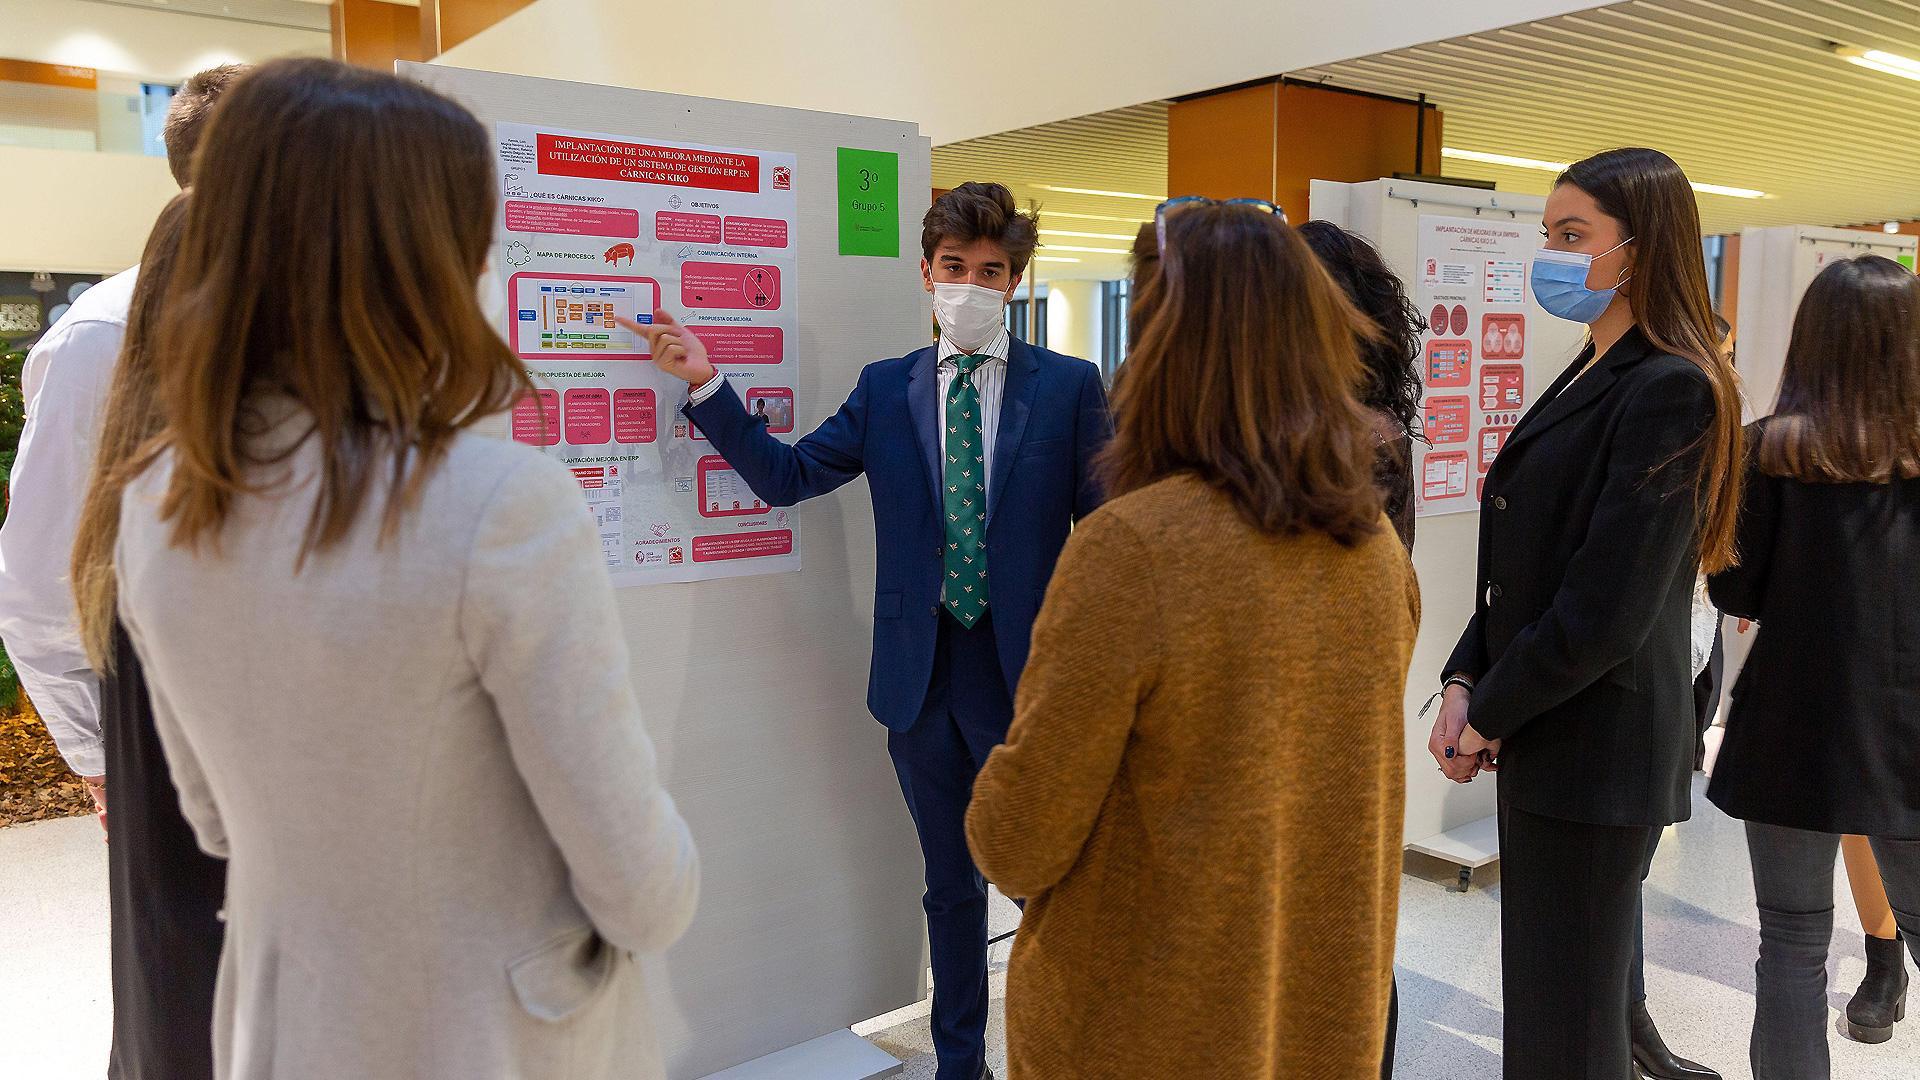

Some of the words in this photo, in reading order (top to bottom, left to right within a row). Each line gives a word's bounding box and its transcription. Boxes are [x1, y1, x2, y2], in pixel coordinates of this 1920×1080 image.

[555, 140, 623, 155] IMPLANTACIÓN
[624, 148, 636, 156] DE
[638, 148, 657, 158] UNA
[658, 151, 691, 161] MEJORA
[692, 154, 734, 166] MEDIANTE
[735, 159, 746, 167] LA
[549, 152, 608, 164] UTILIZACIÓN
[610, 158, 622, 166] DE
[623, 158, 636, 167] UN
[638, 160, 674, 171] SISTEMA
[675, 164, 687, 172] DE
[688, 164, 722, 174] GESTIÓN
[723, 168, 738, 177] ERP
[739, 170, 750, 178] EN
[620, 169, 666, 181] CÁRNICAS
[667, 174, 690, 183] KIKO
[852, 200, 878, 212] Grupo
[697, 250, 736, 258] COMUNICACIÓN
